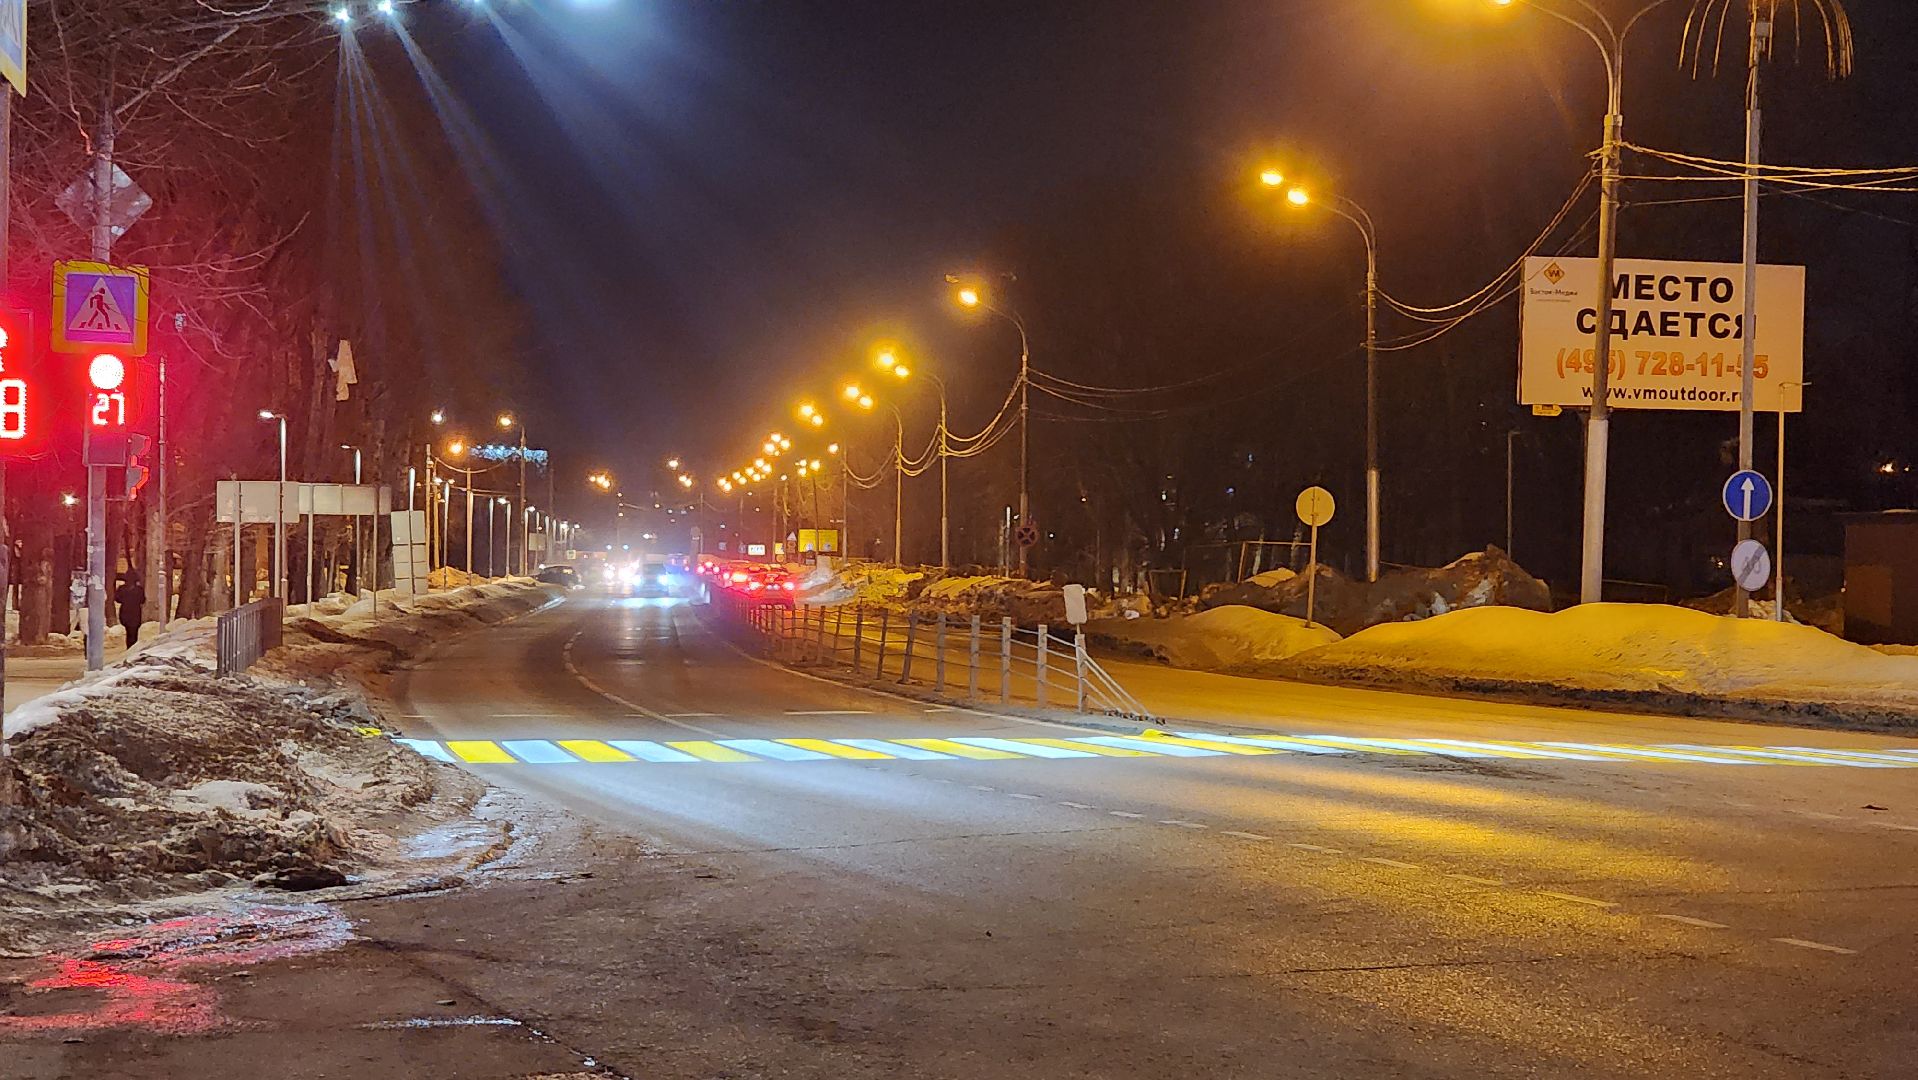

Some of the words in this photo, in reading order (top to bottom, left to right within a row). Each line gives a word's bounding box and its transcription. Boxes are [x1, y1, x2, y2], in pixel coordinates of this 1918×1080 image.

[1612, 274, 1734, 304] МЕСТО
[92, 393, 125, 426] 27
[1582, 386, 1742, 403] ww.vmoutdoor.r
